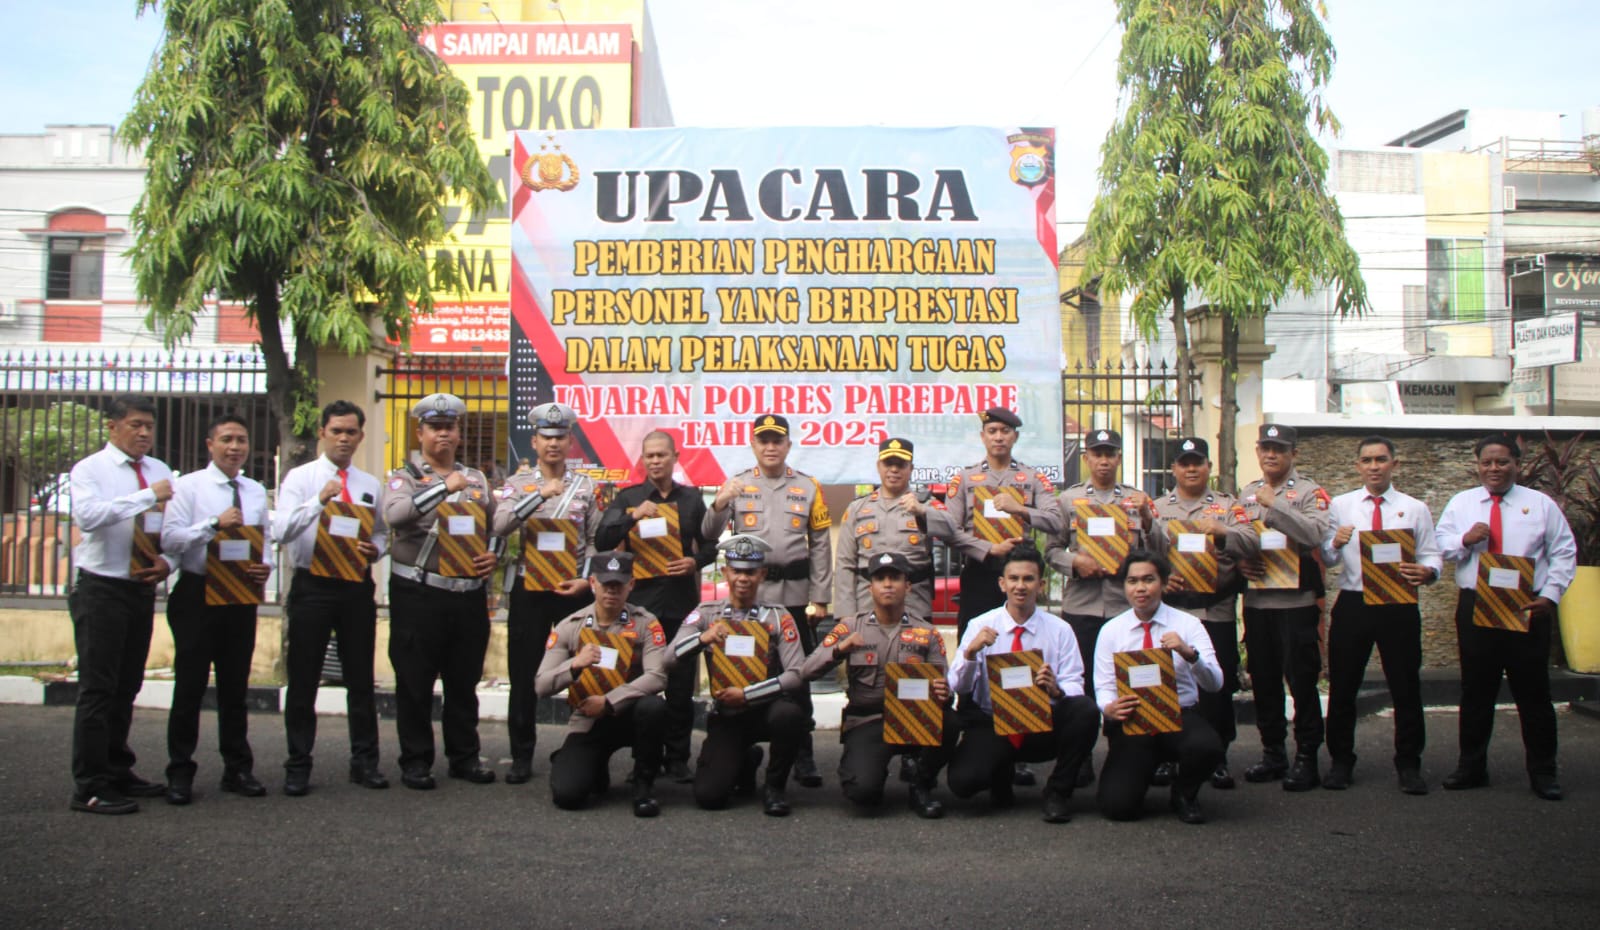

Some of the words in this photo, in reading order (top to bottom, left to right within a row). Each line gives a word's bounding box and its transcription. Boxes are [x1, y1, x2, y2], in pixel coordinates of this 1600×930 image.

[443, 32, 528, 56] SAMPAI
[536, 32, 620, 55] MALAM
[477, 75, 602, 140] TOKO
[593, 169, 979, 222] UPACARA
[573, 239, 754, 276] PEMBERIAN
[763, 238, 996, 275] PENGHARGAAN
[552, 289, 708, 325] PERSONEL
[716, 288, 800, 323] YANG
[808, 288, 1020, 323] BERPRESTASI
[566, 336, 671, 373] DALAM
[681, 335, 899, 372] PELAKSANAAN
[907, 335, 1006, 371] TUGAS
[555, 386, 692, 420] JAJARAN
[704, 385, 832, 415] POLRES
[844, 385, 1018, 415] PAREPARE
[1404, 384, 1456, 396] KEMASAN
[800, 421, 889, 446] 2025
